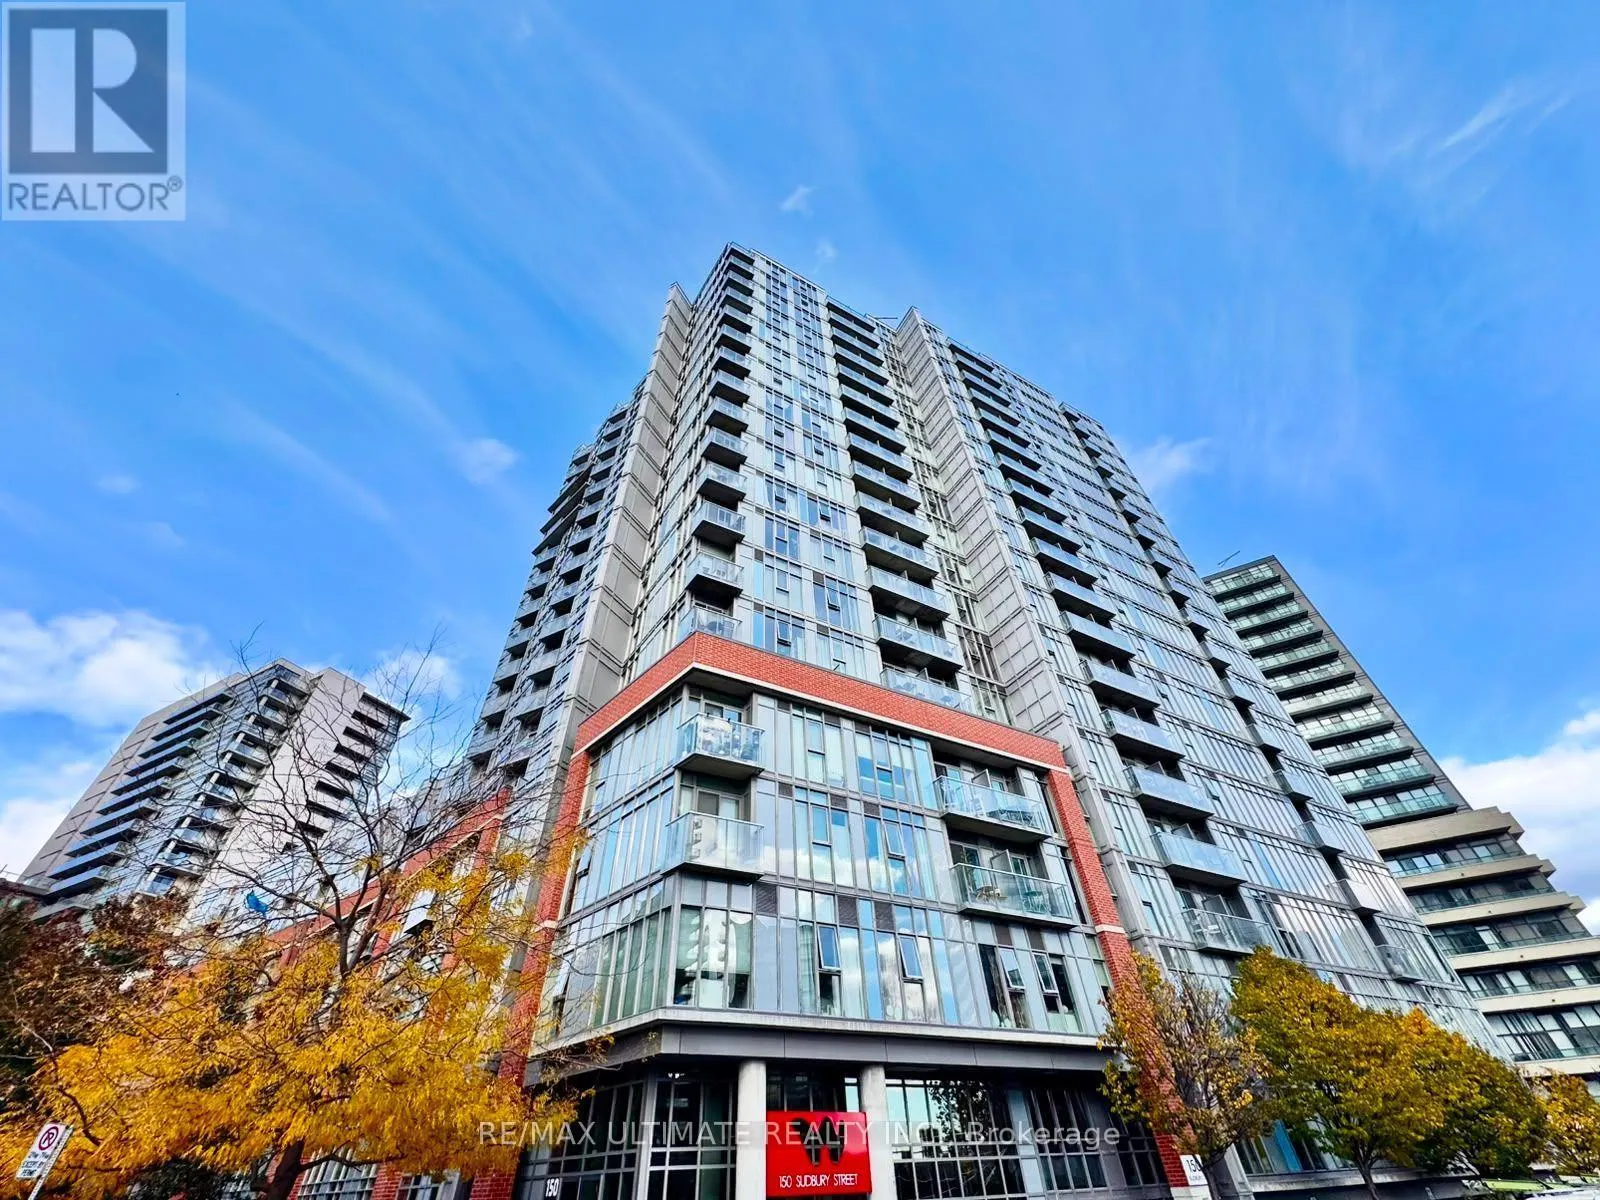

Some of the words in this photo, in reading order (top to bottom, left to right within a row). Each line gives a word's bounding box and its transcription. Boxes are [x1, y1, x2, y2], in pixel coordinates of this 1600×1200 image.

[545, 1178, 560, 1197] 150
[779, 1175, 792, 1189] 150
[796, 1174, 831, 1188] SUDBURY
[834, 1173, 858, 1186] STREET
